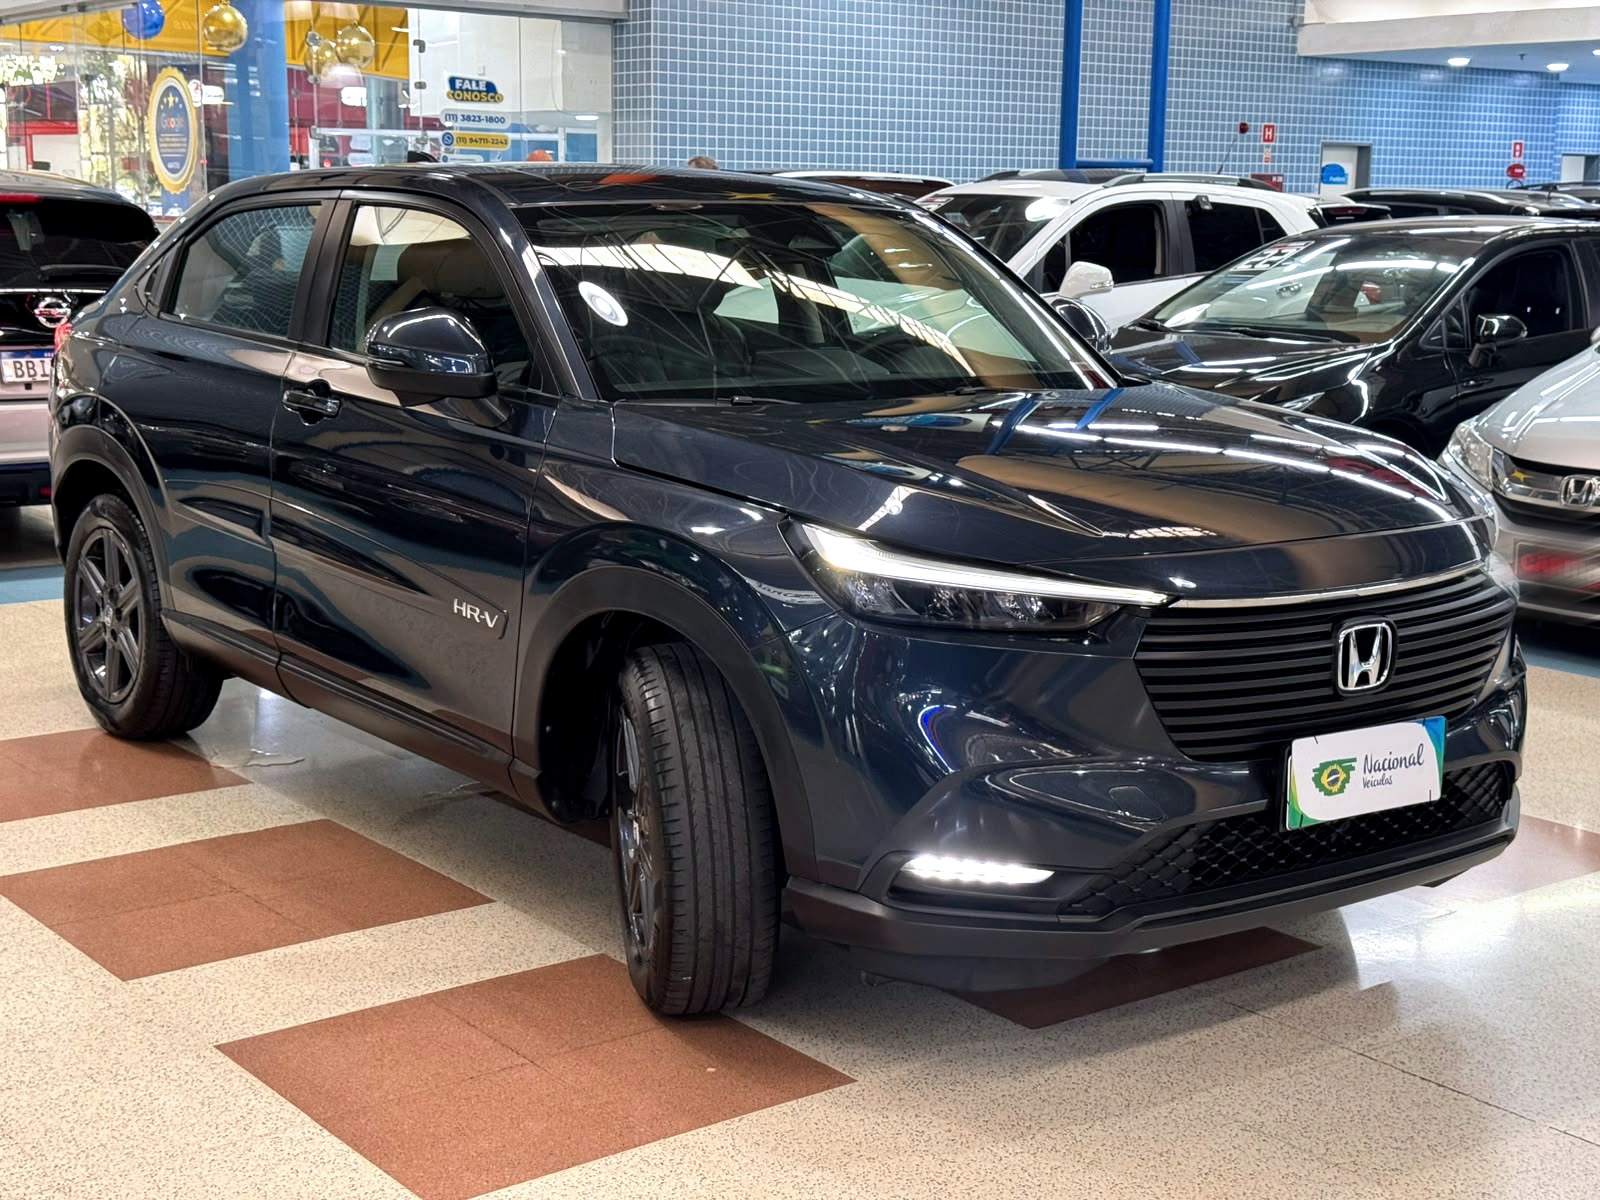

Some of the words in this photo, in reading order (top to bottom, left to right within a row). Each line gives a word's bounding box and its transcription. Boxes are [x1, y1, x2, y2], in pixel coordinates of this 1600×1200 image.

[455, 78, 487, 91] FALE
[447, 90, 504, 103] CONOSCO
[444, 113, 458, 123] (11)
[460, 114, 506, 124] 3823-1800
[455, 136, 468, 145] (11)
[13, 359, 50, 378] BBI
[453, 598, 499, 628] HR-V
[1363, 743, 1425, 775] Nacional
